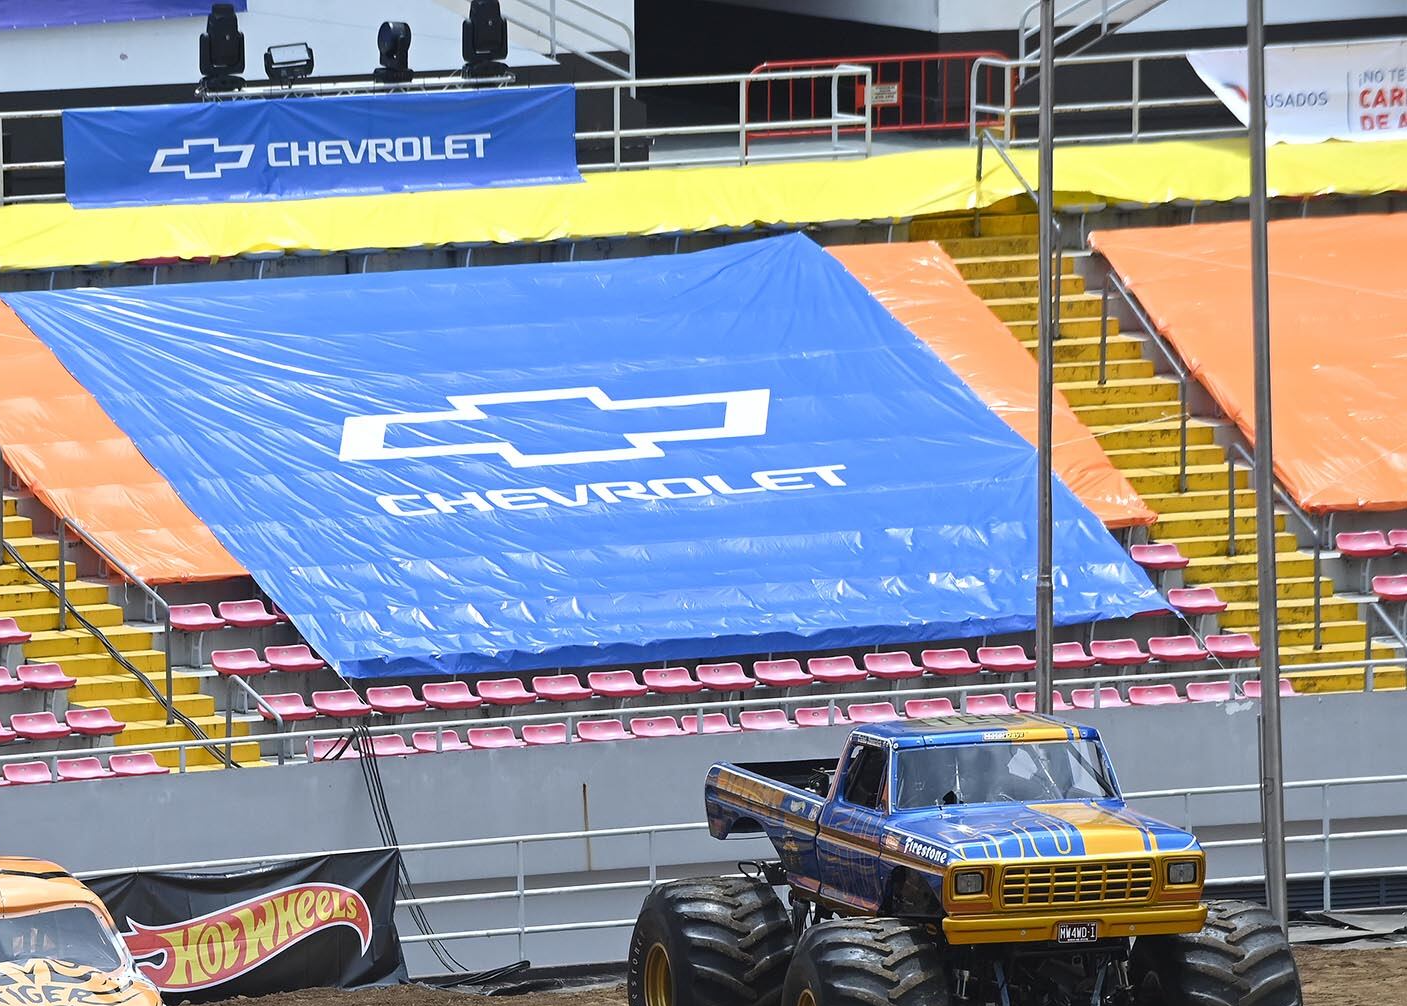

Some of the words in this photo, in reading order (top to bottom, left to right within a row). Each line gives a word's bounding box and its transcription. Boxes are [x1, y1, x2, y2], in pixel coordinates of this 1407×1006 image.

[1359, 87, 1407, 109] CAR
[1360, 114, 1390, 130] DE
[267, 132, 491, 168] CHEVROLET
[375, 464, 848, 518] CHEVROLET
[903, 836, 948, 864] Firestone
